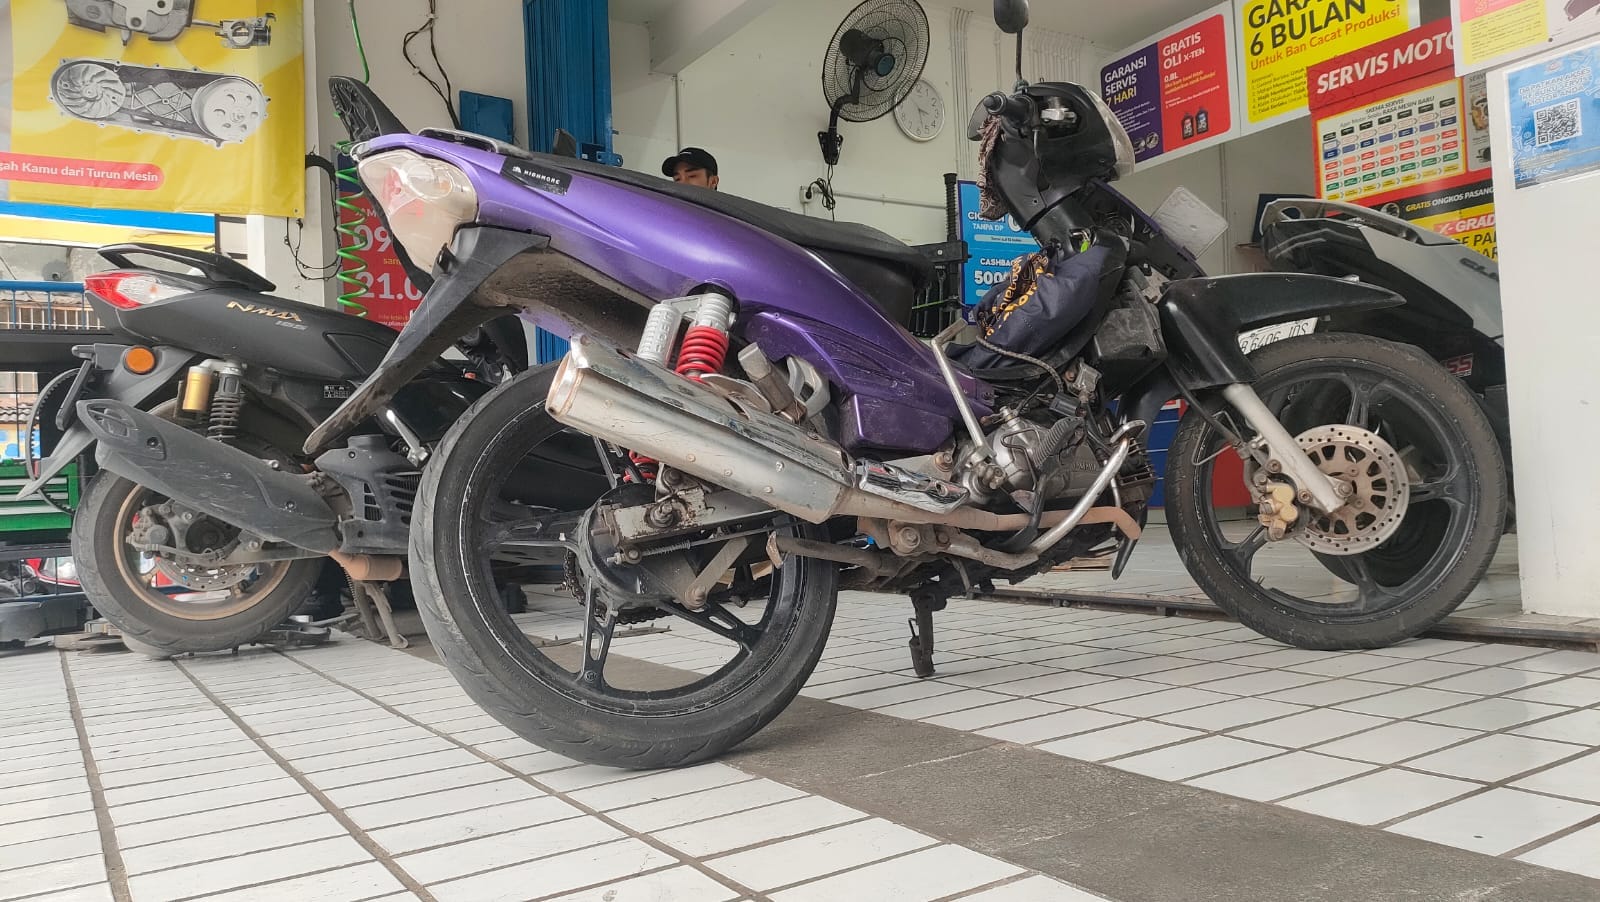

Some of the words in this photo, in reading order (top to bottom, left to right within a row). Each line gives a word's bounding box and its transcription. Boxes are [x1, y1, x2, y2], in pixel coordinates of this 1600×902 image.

[1250, 32, 1264, 56] 6
[1271, 0, 1366, 48] BULAN
[1251, 52, 1283, 70] Untuk
[1286, 43, 1307, 58] Ban
[1309, 28, 1342, 48] Cacat
[1345, 4, 1400, 37] Produksi
[1162, 32, 1201, 57] GRATIS
[1163, 53, 1181, 69] OLI
[1184, 47, 1205, 62] X-TEN
[1104, 56, 1147, 83] GARANSI
[1316, 52, 1389, 94] SERVIS
[1105, 74, 1137, 96] SERVIS
[1114, 86, 1137, 105] HARI
[22, 162, 58, 175] Kamu
[61, 166, 84, 177] dari
[86, 168, 121, 179] Turun
[123, 171, 158, 182] Mesin
[1405, 200, 1431, 212] GRATIS
[1431, 193, 1464, 206] ONGKOS
[226, 301, 302, 321] NMAX
